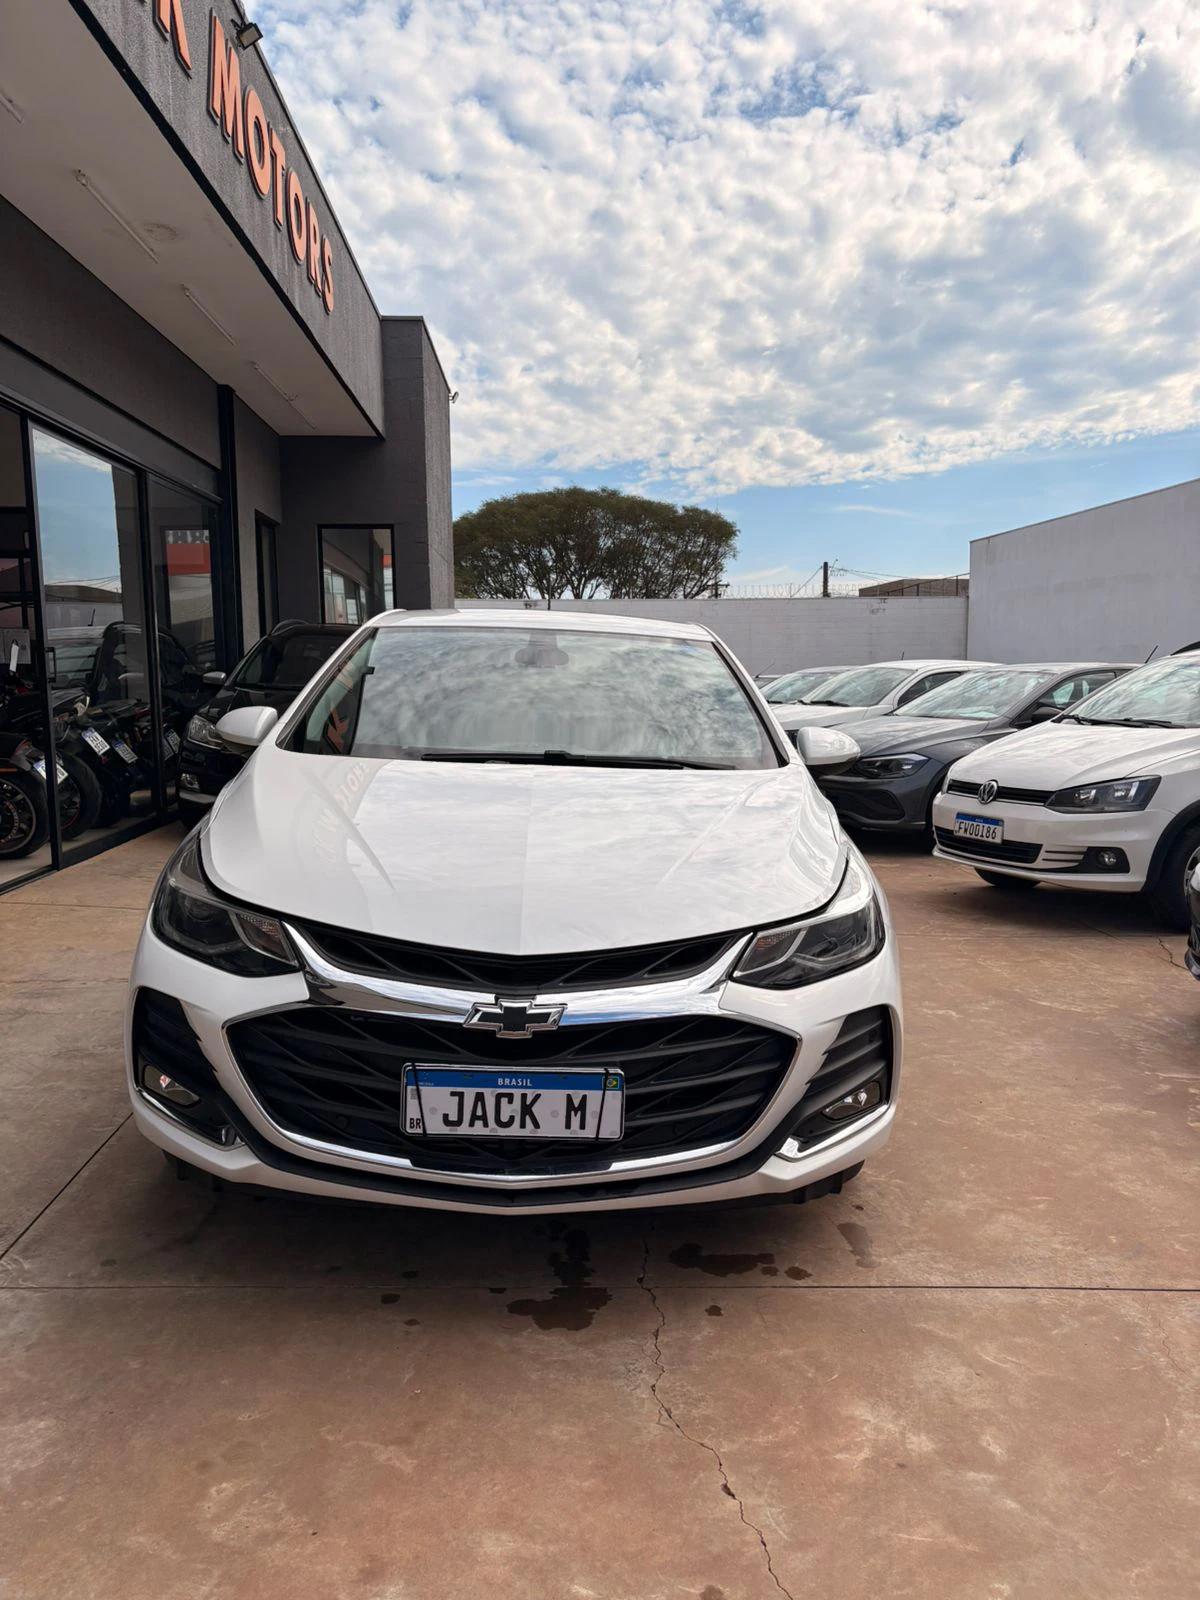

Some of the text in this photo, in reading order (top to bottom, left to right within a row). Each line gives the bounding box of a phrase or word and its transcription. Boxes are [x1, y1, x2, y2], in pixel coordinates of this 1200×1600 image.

[209, 9, 334, 313] MOTORS
[497, 1077, 532, 1087] BRASIL
[409, 1117, 422, 1130] BR
[442, 1091, 588, 1130] JACK M
